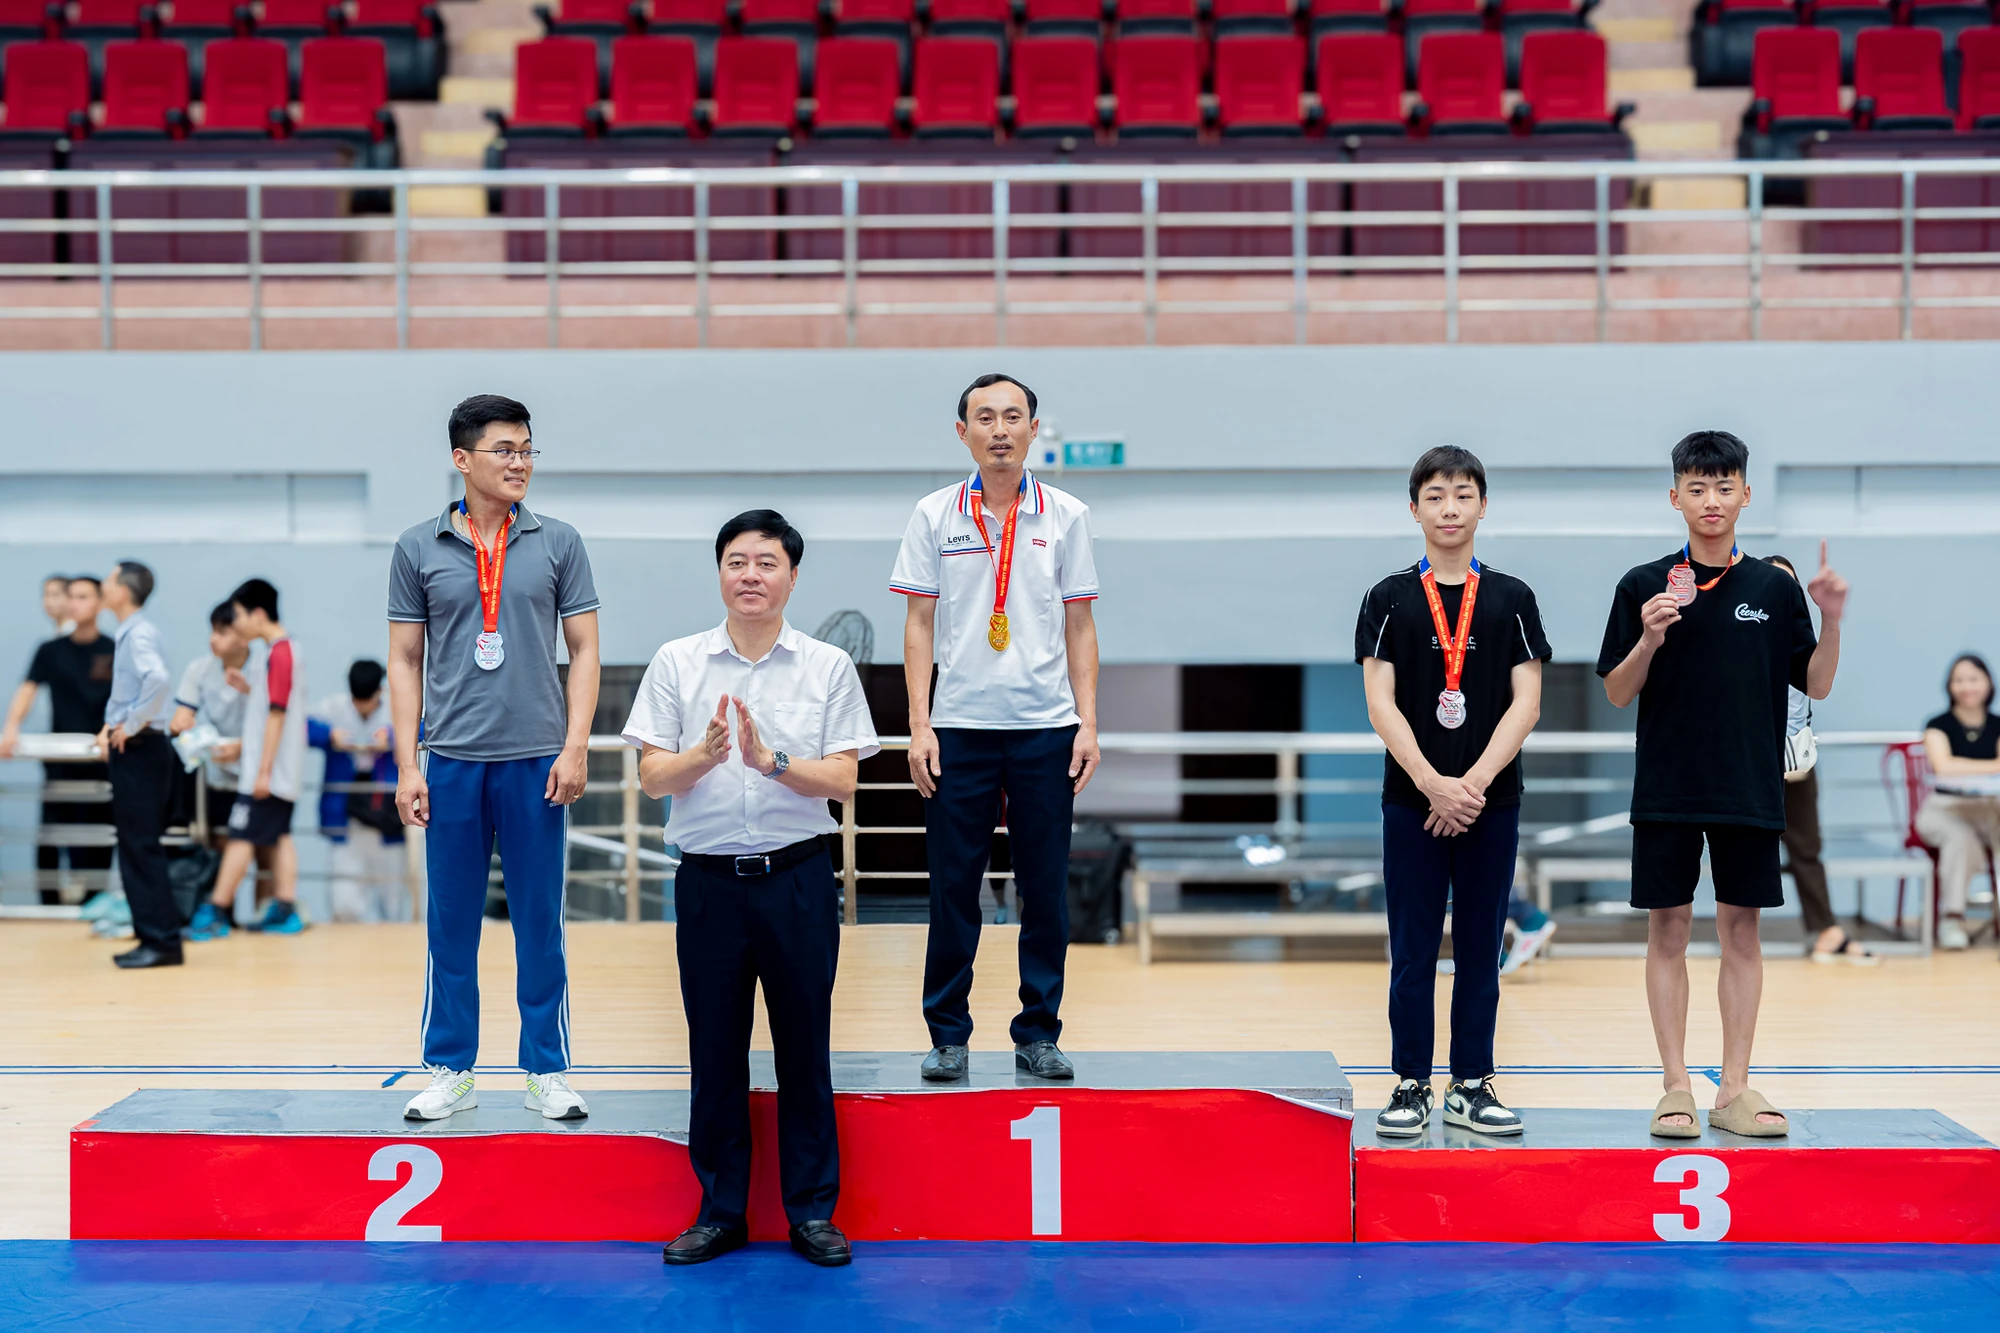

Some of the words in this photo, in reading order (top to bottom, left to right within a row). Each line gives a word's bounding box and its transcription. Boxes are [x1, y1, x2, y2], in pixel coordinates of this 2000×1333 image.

[365, 1144, 443, 1242] 2
[1010, 1106, 1062, 1235] 1
[1653, 1154, 1731, 1242] 3
